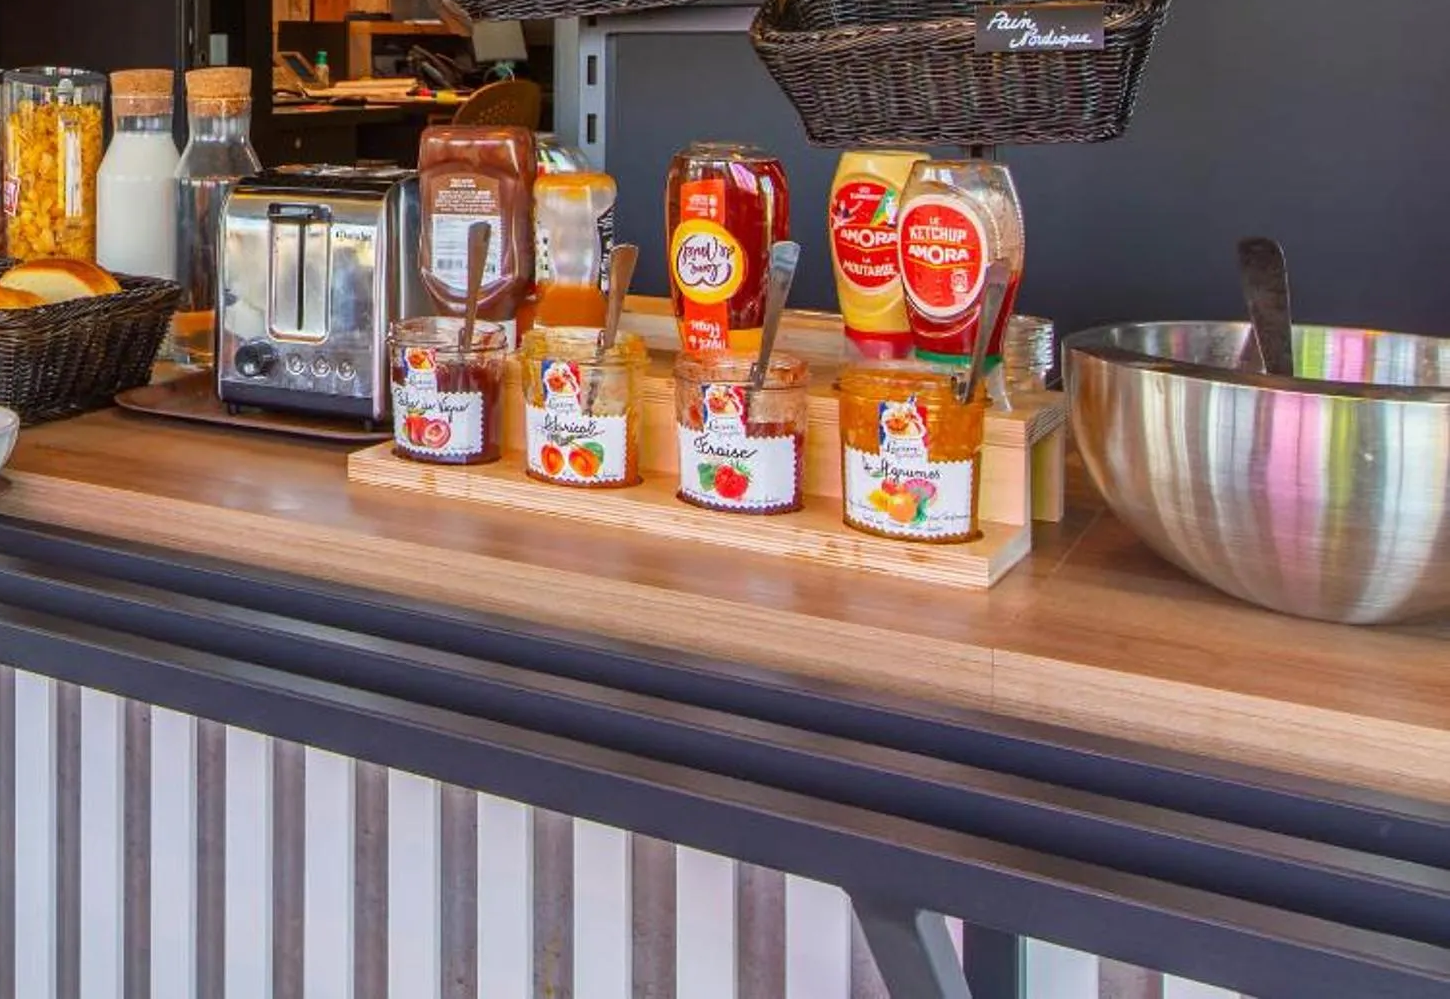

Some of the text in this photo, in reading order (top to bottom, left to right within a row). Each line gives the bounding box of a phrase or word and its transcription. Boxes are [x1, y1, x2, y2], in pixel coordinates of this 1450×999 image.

[986, 11, 1037, 30] Pain
[1009, 25, 1094, 48] Nordique
[840, 229, 898, 248] AMORA
[910, 225, 967, 243] KETCHUP
[908, 244, 970, 265] AMORA
[694, 432, 758, 459] Fraise
